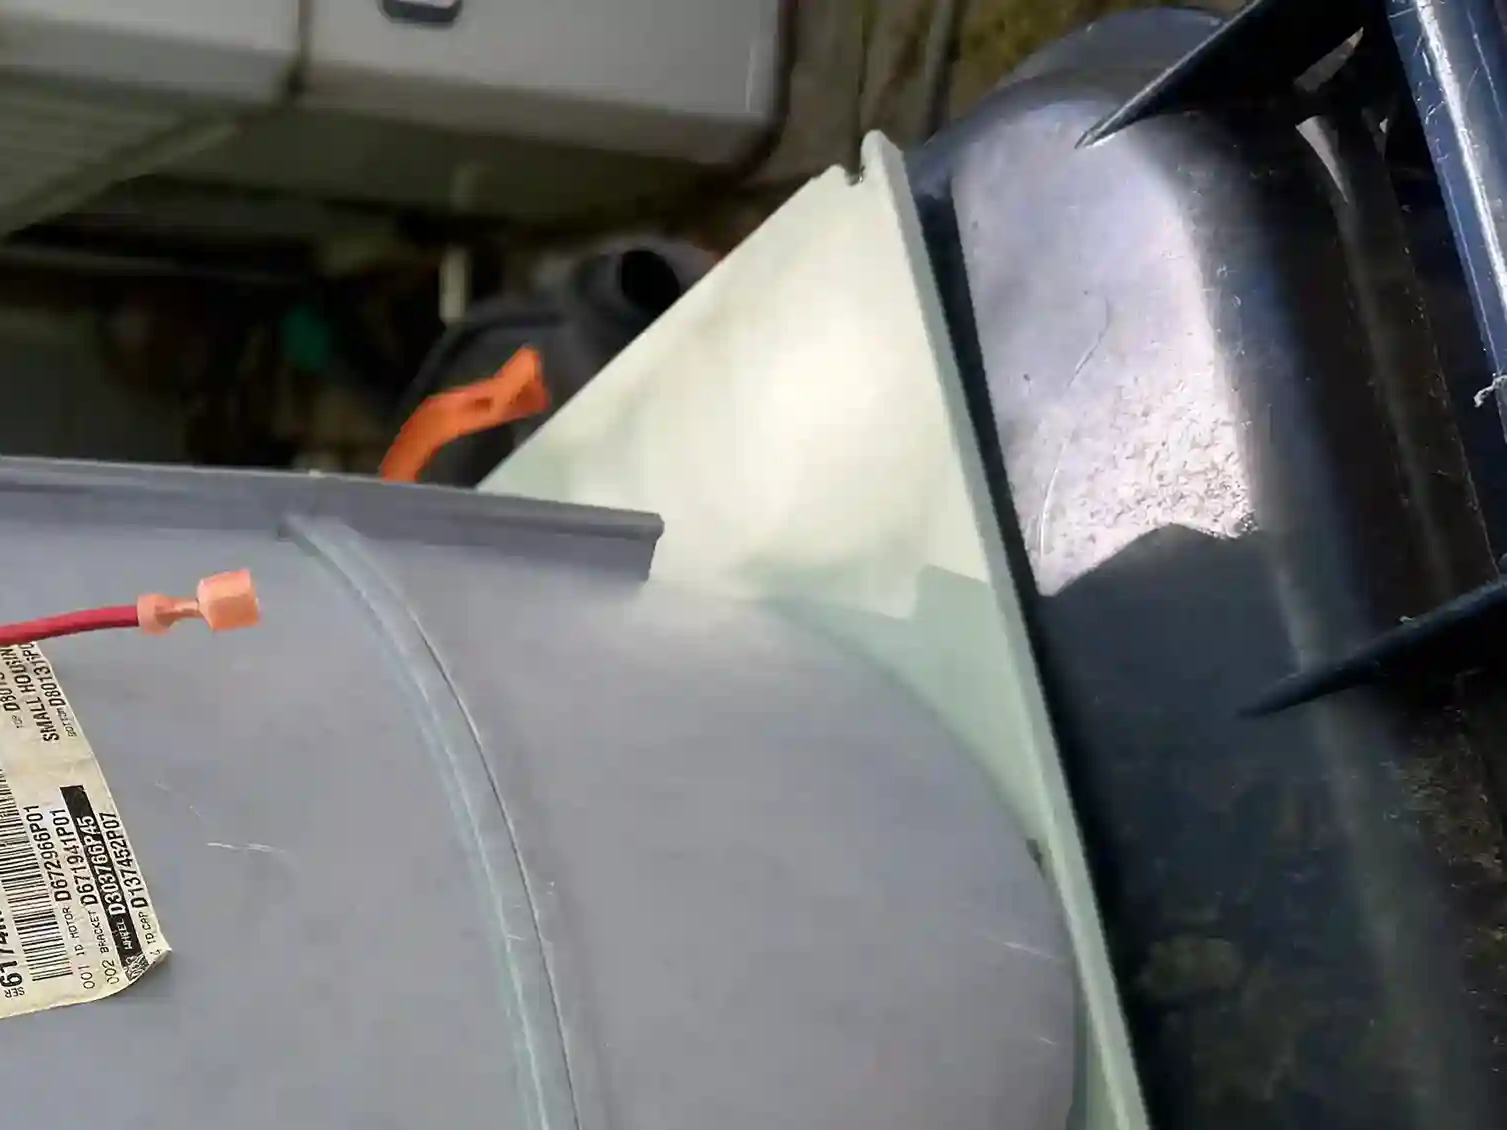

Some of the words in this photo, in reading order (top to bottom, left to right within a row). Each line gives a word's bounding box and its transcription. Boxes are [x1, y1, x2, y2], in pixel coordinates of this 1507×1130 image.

[25, 697, 59, 742] SMALL
[23, 805, 72, 902] D672966P01
[49, 808, 98, 906] D671941P01
[76, 815, 126, 915] D303766P45
[99, 812, 149, 908] D137452P07
[63, 907, 81, 938] MOTOR
[88, 910, 110, 953] BRACKET
[138, 912, 151, 930] CAP
[4, 987, 24, 998] SER
[78, 964, 96, 989] 001
[102, 960, 119, 984] 002
